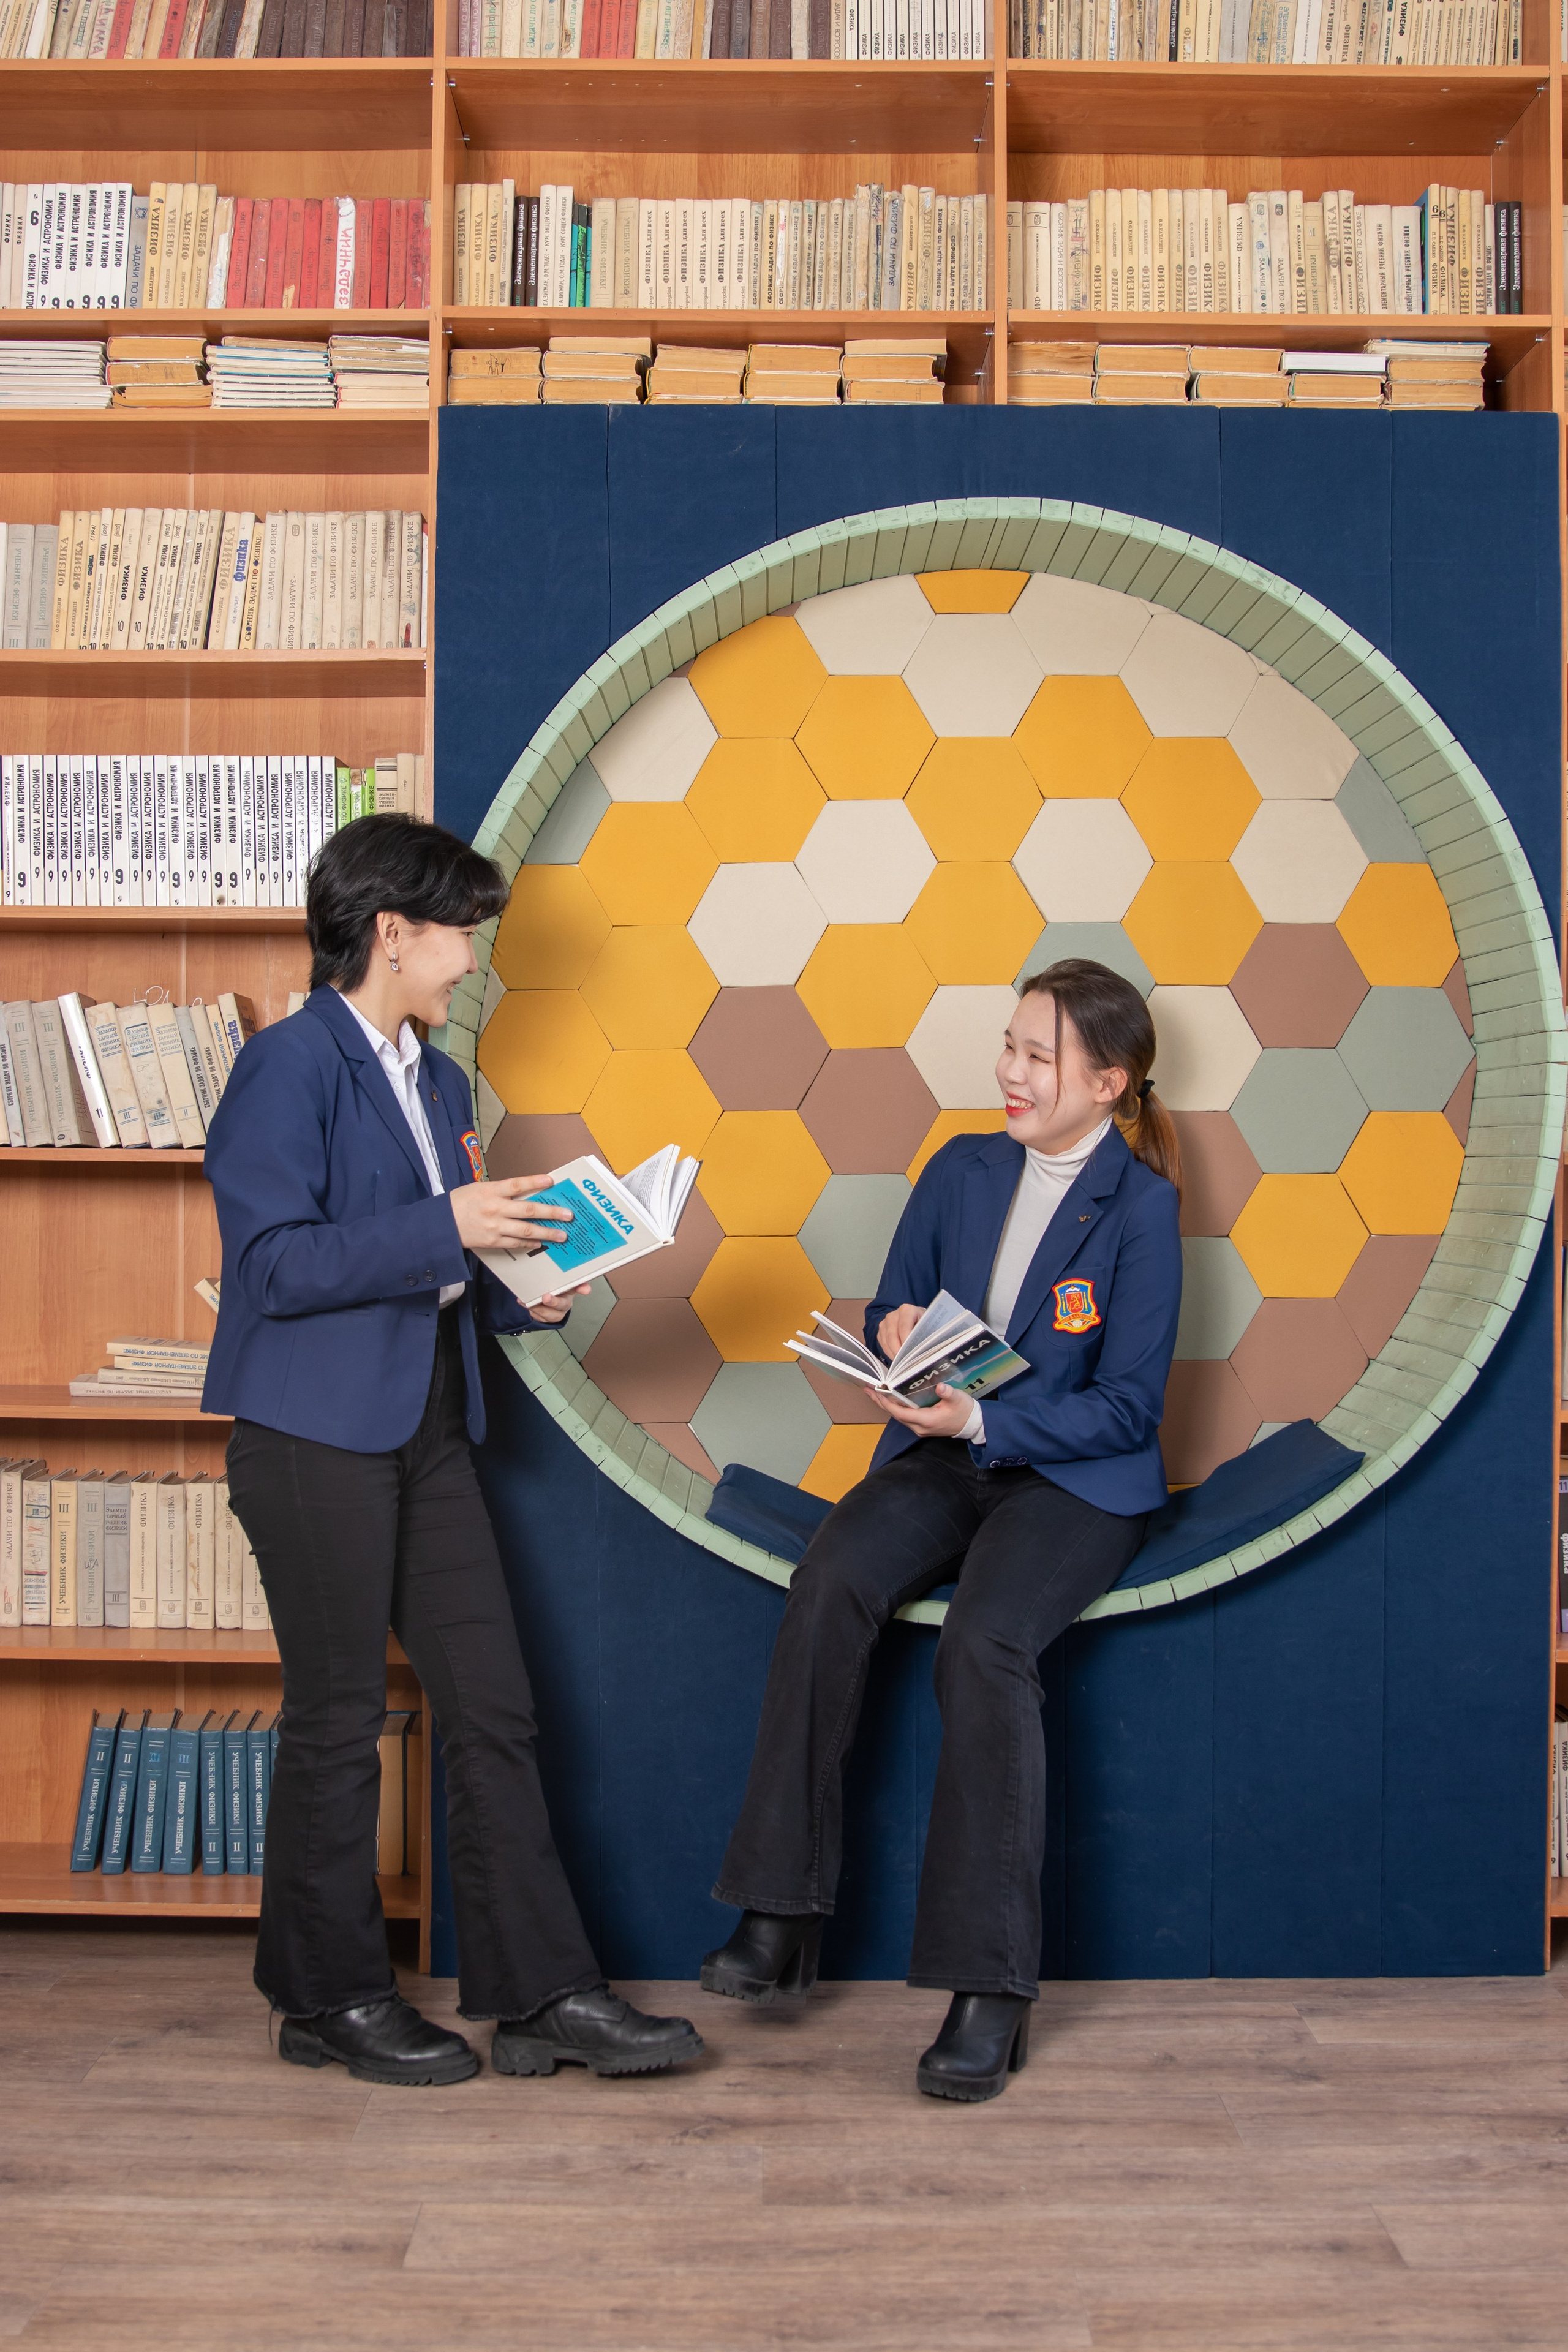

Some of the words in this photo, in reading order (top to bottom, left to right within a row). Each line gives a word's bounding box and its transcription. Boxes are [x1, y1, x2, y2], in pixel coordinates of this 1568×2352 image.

[1398, 2, 1408, 37] ФИЗИКА
[43, 200, 53, 244] АСТРОНОМИЯ
[72, 195, 81, 233] АСТРОНОМИЯ
[117, 190, 126, 230] АСТРОНОМИЯ
[150, 207, 160, 255] ФИЗИКА
[197, 208, 209, 257] ФИЗИКА
[457, 208, 466, 257] ФИЗИКА
[489, 213, 499, 262] ФИЗИКА
[769, 241, 774, 250] ПО
[889, 237, 897, 250] ПО
[1343, 205, 1353, 267] ФИЗИКА
[1447, 203, 1455, 266] ФИЗИКА
[69, 244, 78, 271] ФИЗИКА
[115, 241, 123, 267] ФИЗИКА
[132, 245, 141, 277] ЗАДАЧИ
[514, 232, 525, 285] Элементарная
[1499, 236, 1508, 290] Элементарная
[41, 257, 50, 285] ФИЗИКА
[131, 281, 138, 293] ПО
[1279, 291, 1284, 301] ПО
[1379, 272, 1388, 310] ЭЛЕМЕНТАРНЫЙ
[58, 537, 69, 587] ФИЗИКА
[233, 539, 249, 582] Физика
[270, 556, 276, 568] ПО
[407, 554, 413, 567] ПО
[121, 565, 130, 600] ФИЗИКА
[245, 606, 254, 641] СБОРНИК
[252, 568, 258, 580] ПО
[118, 621, 124, 632] 10
[113, 761, 122, 801] АСТРОНОМИЯ
[18, 872, 26, 888] 9
[115, 869, 123, 884] 9
[20, 1050, 30, 1082] ФИЗИКИ
[189, 1047, 200, 1065] ФИЗИКЕ
[197, 1073, 205, 1088] ЗАДАЧ
[25, 1085, 36, 1122] УЧЕБНИК
[200, 1088, 210, 1109] СБОРНИК
[582, 1179, 635, 1235] ФИЗИКА
[147, 1349, 189, 1358] ЭЛЕМЕНТАРНОЙ
[908, 1338, 992, 1390] ФИЗИКА
[965, 1378, 985, 1390] 11
[6, 1516, 12, 1527] ПО
[59, 1504, 69, 1513] III
[97, 1751, 104, 1761] II
[148, 1780, 157, 1813] ФИЗИКИ
[83, 1813, 94, 1851] УЧЕБНИК
[89, 1778, 100, 1811] ФИЗИКИ
[144, 1814, 154, 1853] УЧЕБНИК
[233, 1842, 241, 1852] II
